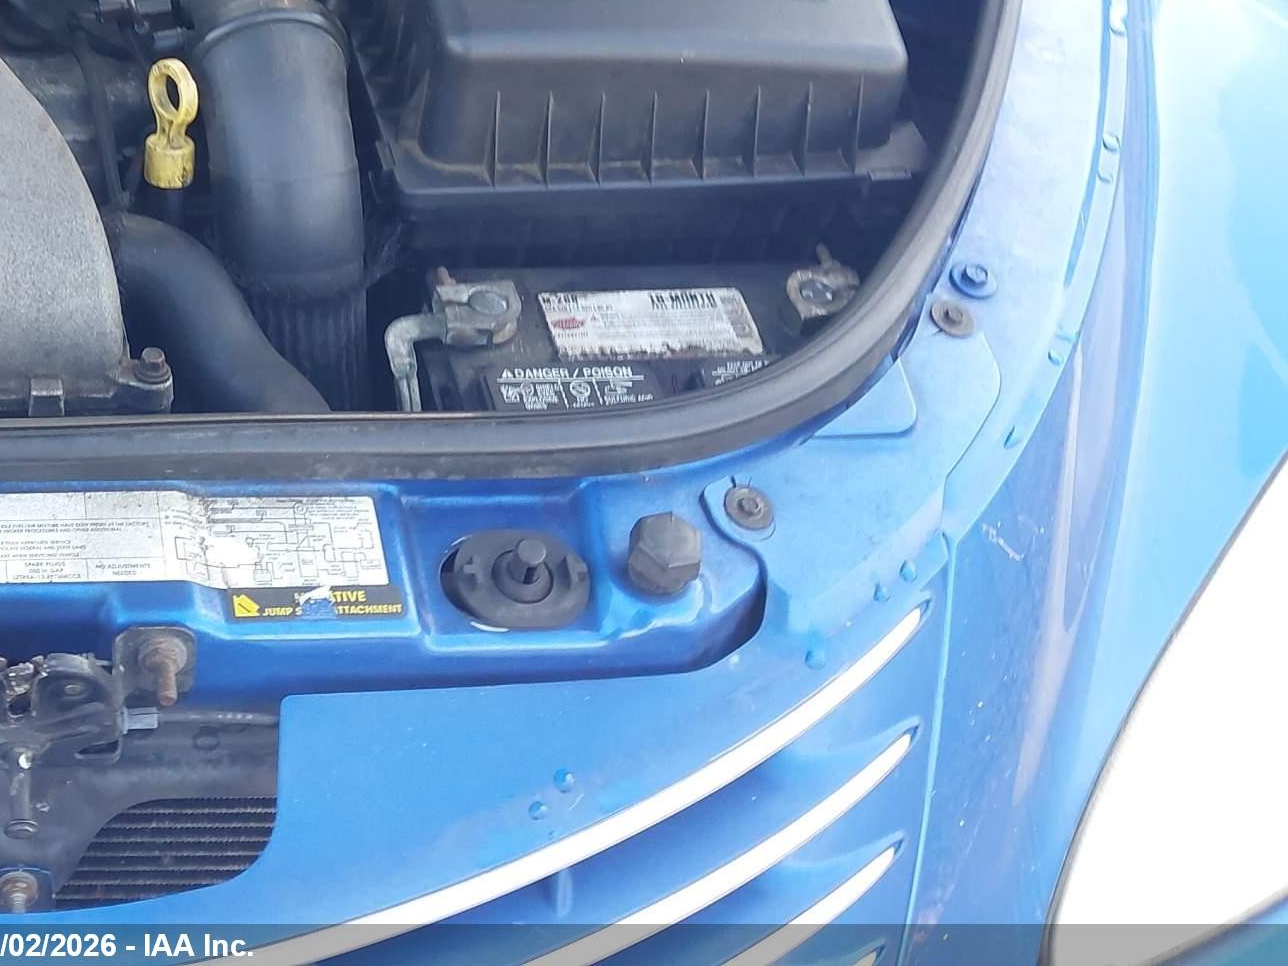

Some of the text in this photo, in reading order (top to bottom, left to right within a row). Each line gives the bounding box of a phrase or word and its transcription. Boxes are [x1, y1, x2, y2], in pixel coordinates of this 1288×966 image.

[514, 367, 569, 379] DANGER
[583, 366, 632, 378] POISON
[263, 607, 293, 616] JUMP
